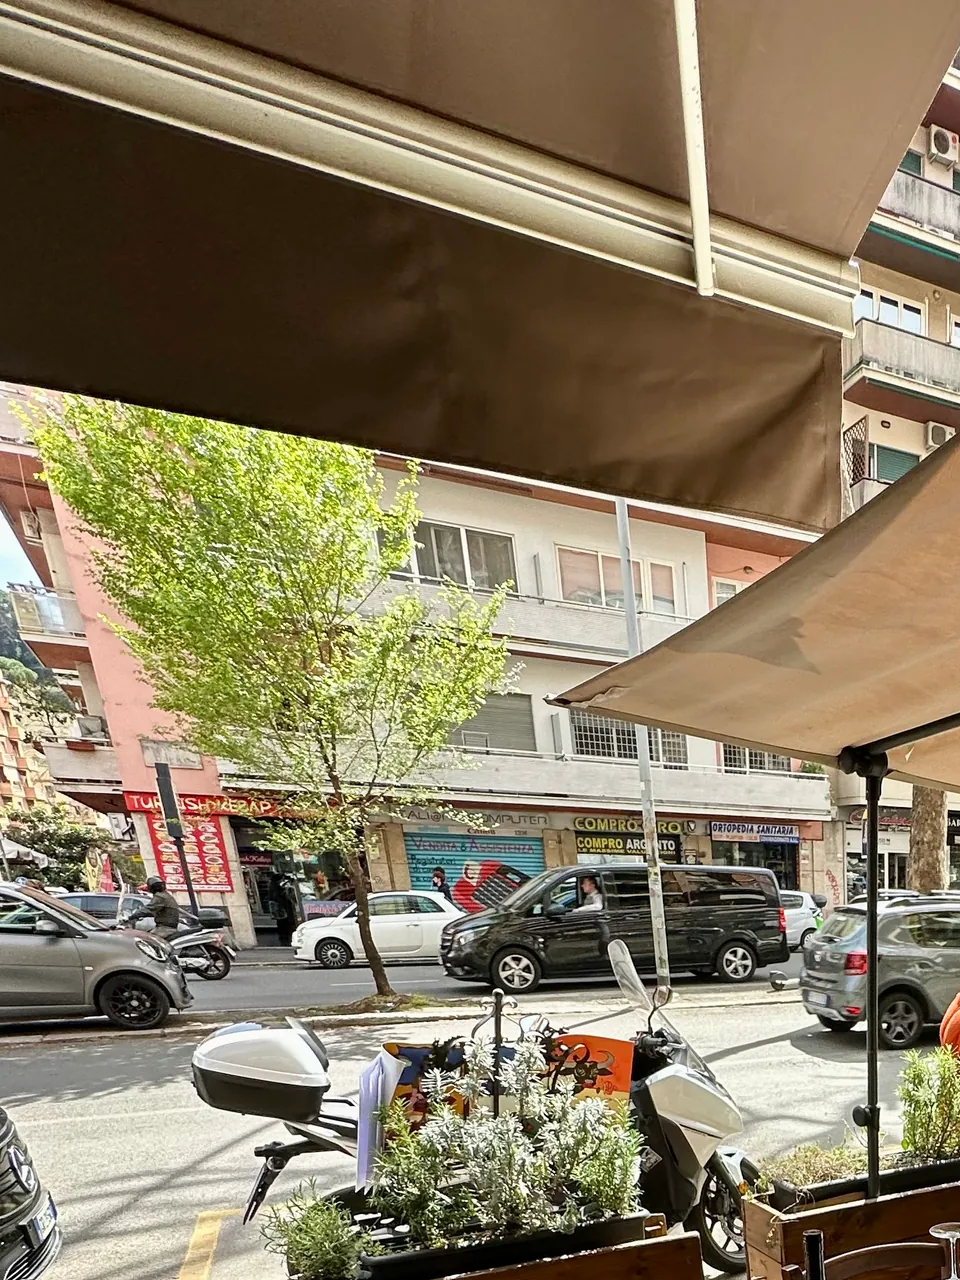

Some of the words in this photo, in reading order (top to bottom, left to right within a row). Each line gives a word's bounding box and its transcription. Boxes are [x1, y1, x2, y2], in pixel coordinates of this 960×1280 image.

[129, 795, 206, 813] TURISH
[478, 813, 548, 825] OMPUTER
[574, 817, 638, 831] COMPRO
[641, 820, 681, 833] RO
[712, 823, 754, 834] ORTOPEDIA
[756, 825, 794, 835] SANITARIA
[577, 837, 623, 849] COMPRO
[626, 839, 676, 850] ARGTO
